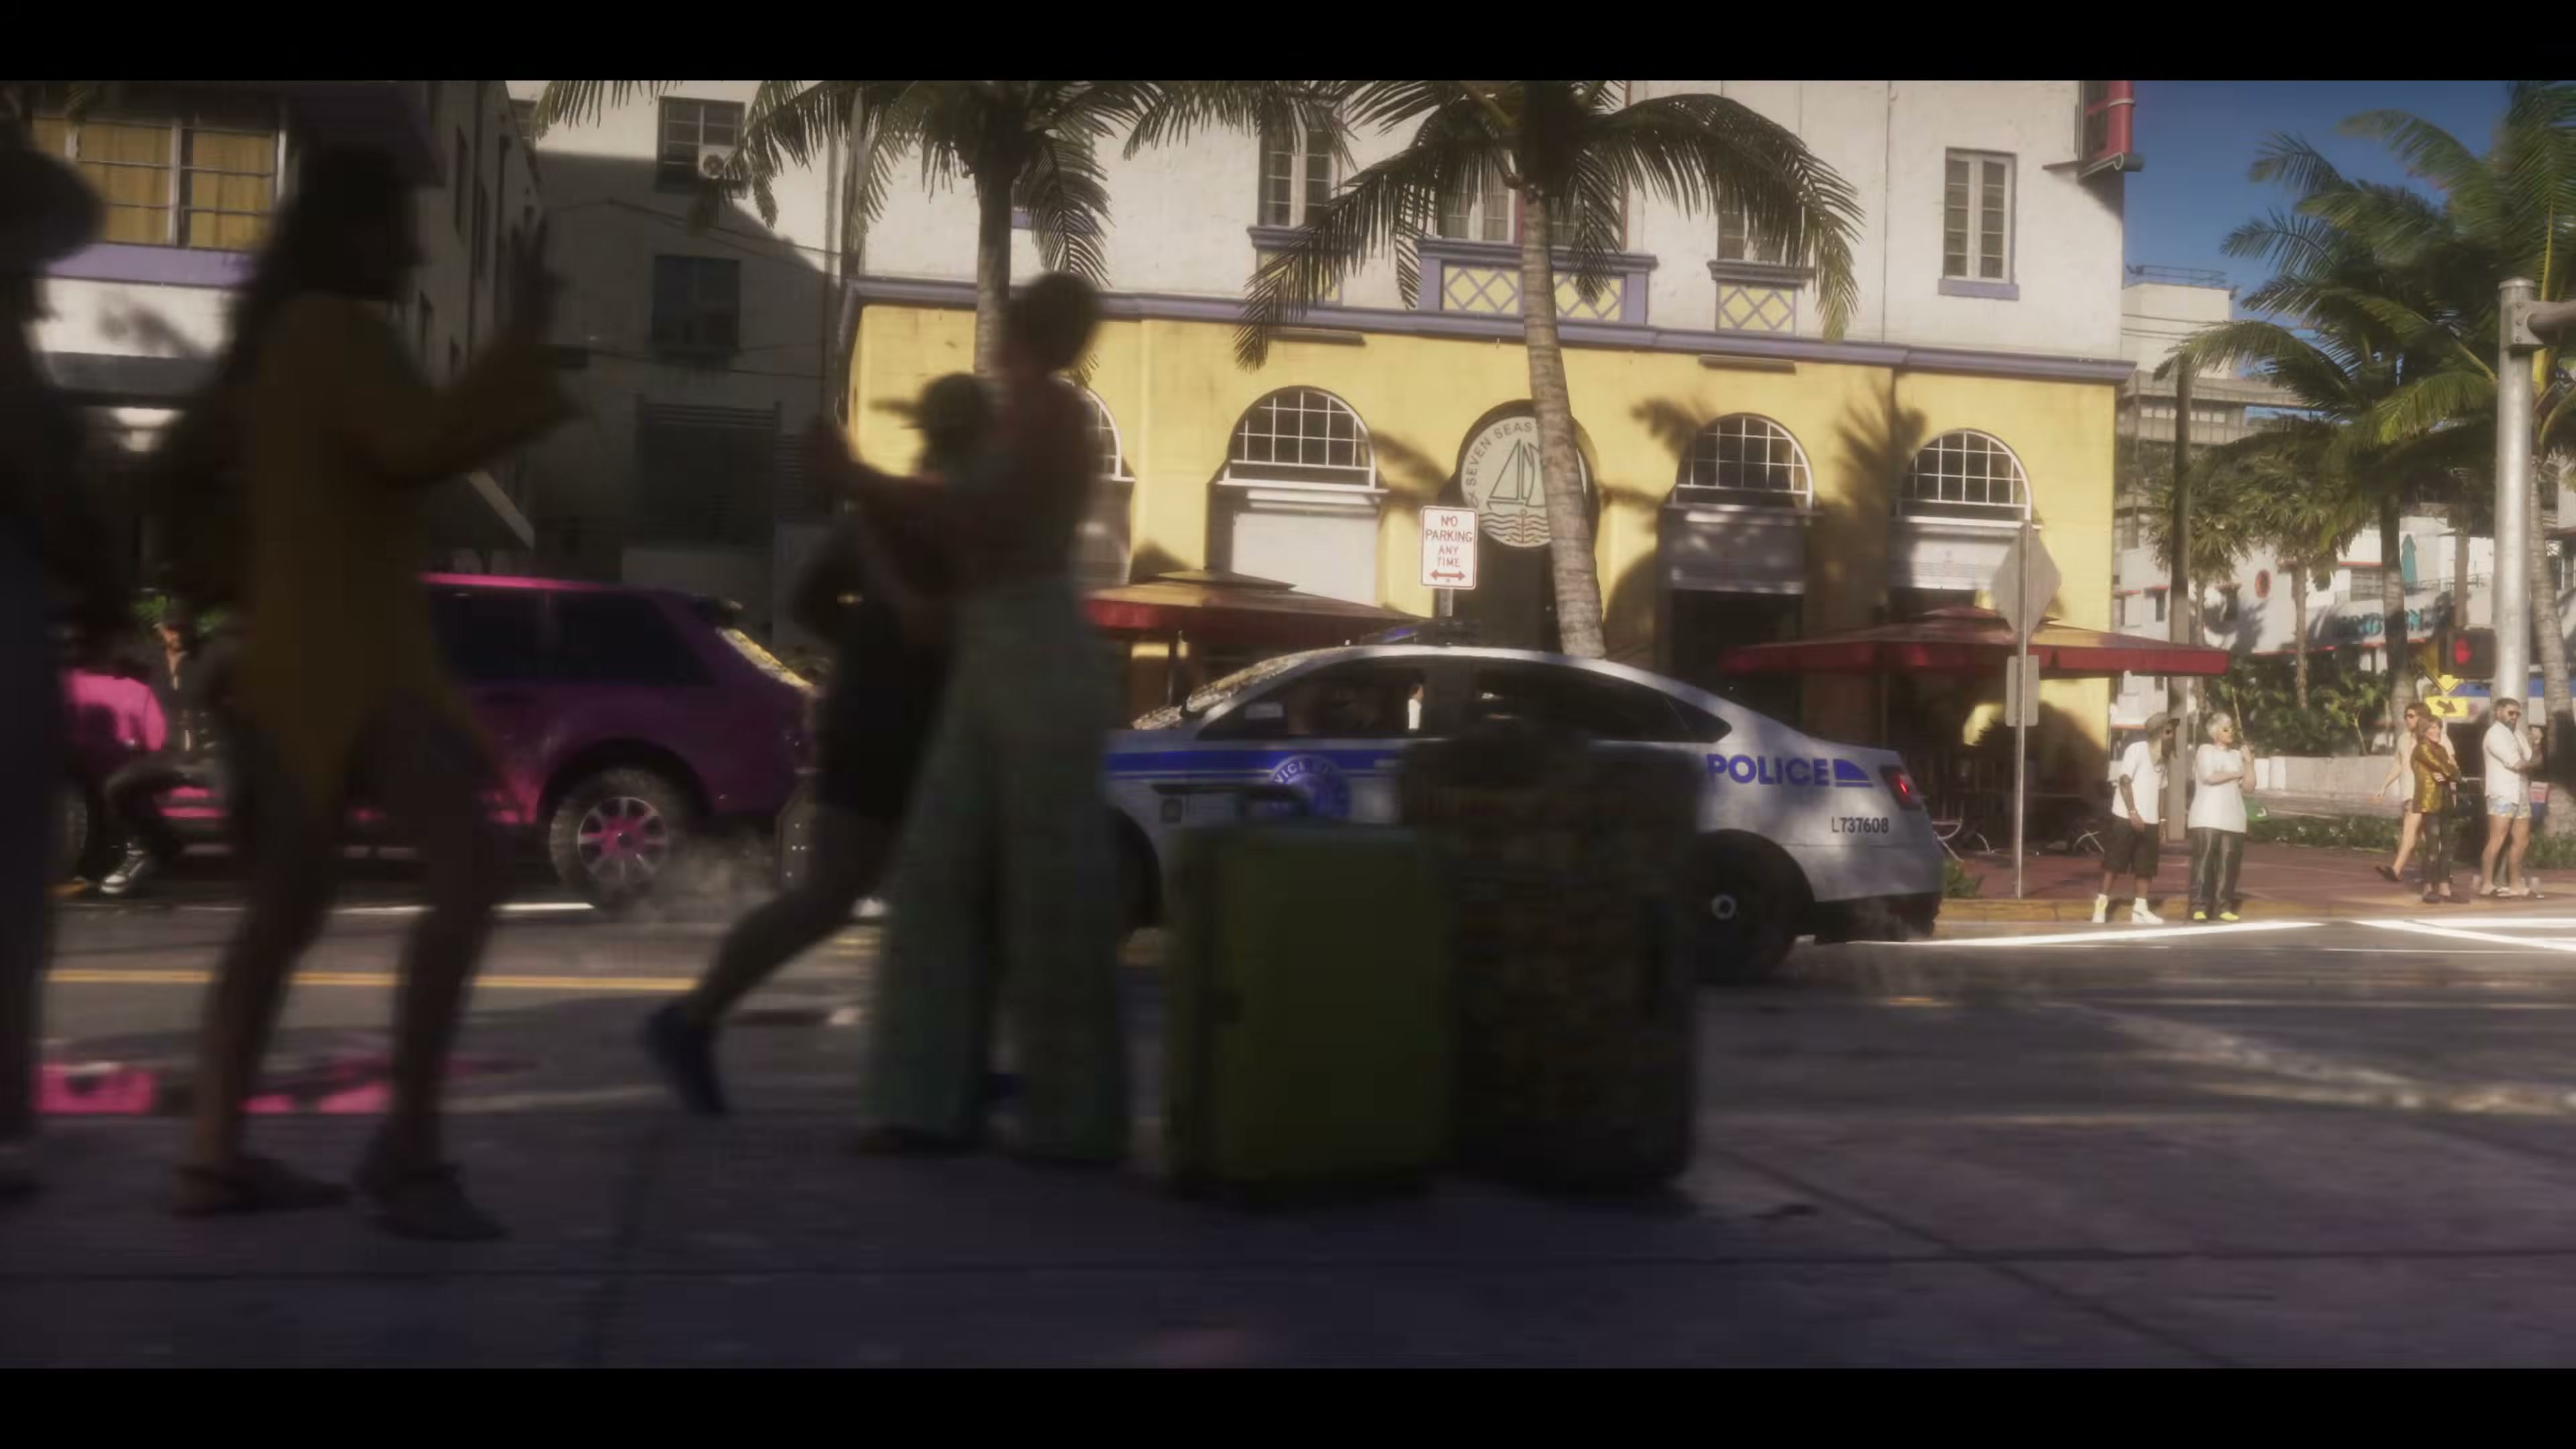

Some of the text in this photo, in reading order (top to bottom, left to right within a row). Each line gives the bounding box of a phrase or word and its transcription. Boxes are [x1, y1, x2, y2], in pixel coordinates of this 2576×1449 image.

[1464, 421, 1533, 486] SEVEN SEAS
[1440, 515, 1458, 527] NO
[1425, 529, 1473, 543] PARKING
[1438, 545, 1459, 556] ANY
[1438, 556, 1460, 568] TIME
[1706, 753, 1830, 787] POLICE
[1831, 816, 1890, 834] L737608
